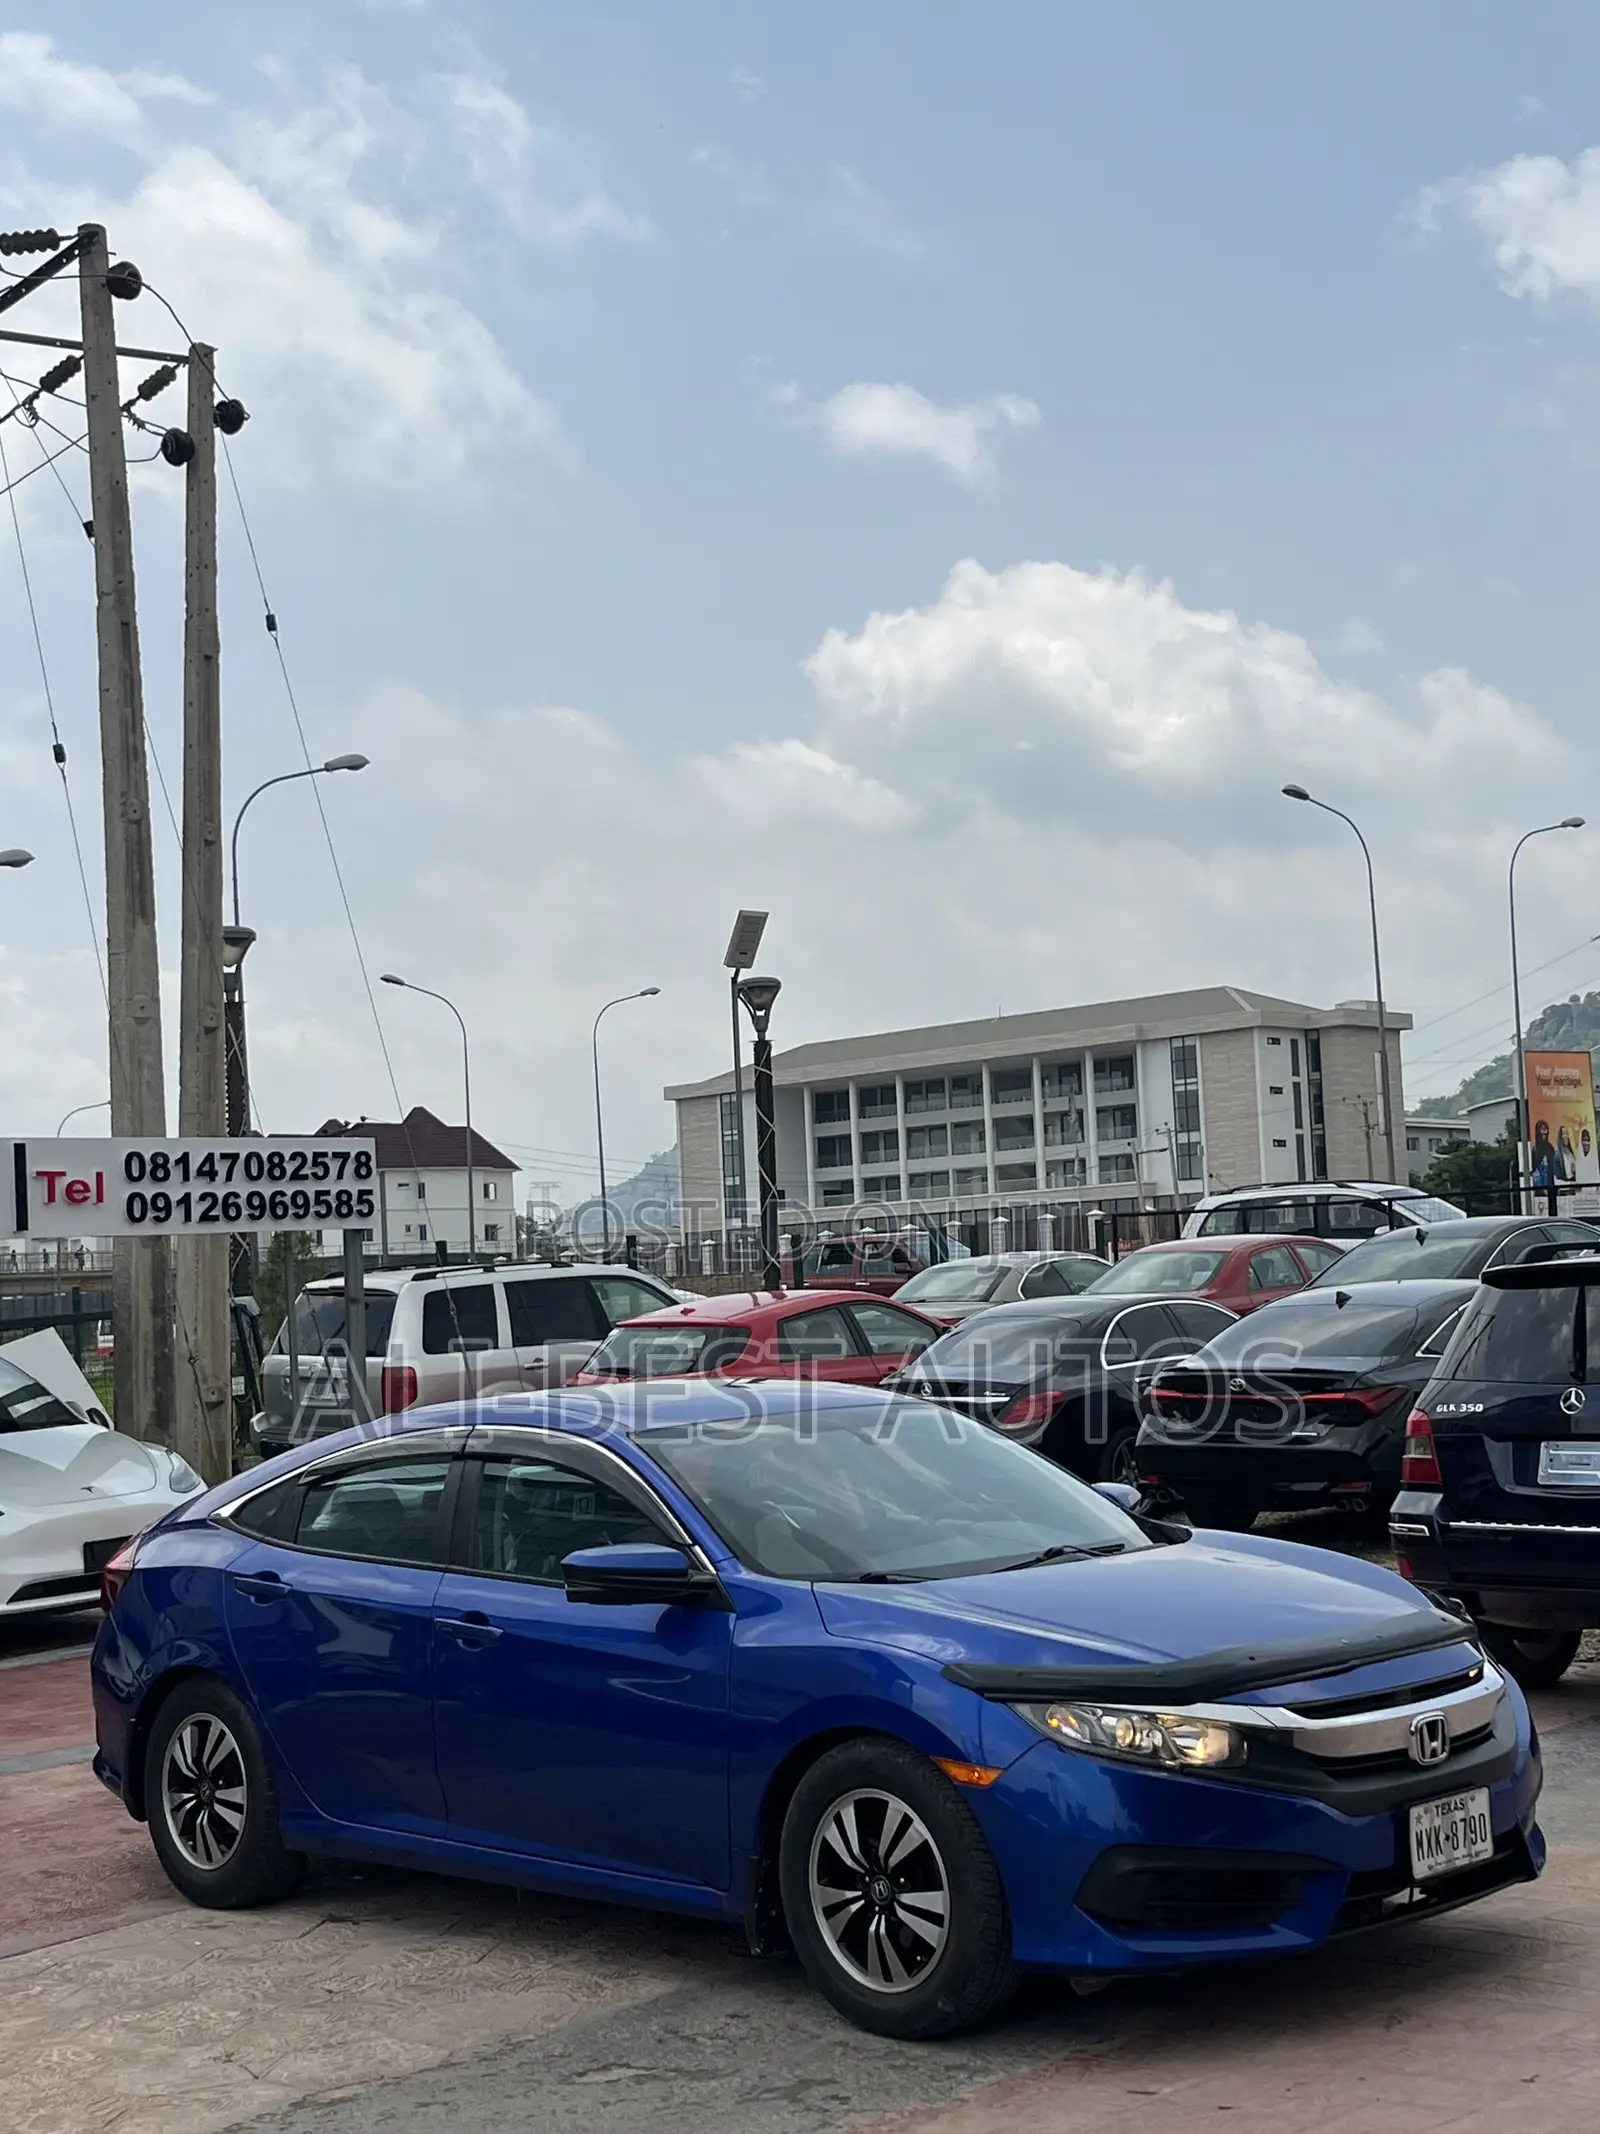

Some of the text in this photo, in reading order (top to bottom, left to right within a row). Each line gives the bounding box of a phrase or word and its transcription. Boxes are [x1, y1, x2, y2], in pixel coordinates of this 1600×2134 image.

[124, 1150, 373, 1183] 08147082578
[34, 1170, 105, 1205] Tel
[126, 1188, 375, 1224] 09126969585
[1436, 1403, 1484, 1413] GLK 350
[1434, 1798, 1465, 1818] TEXAS
